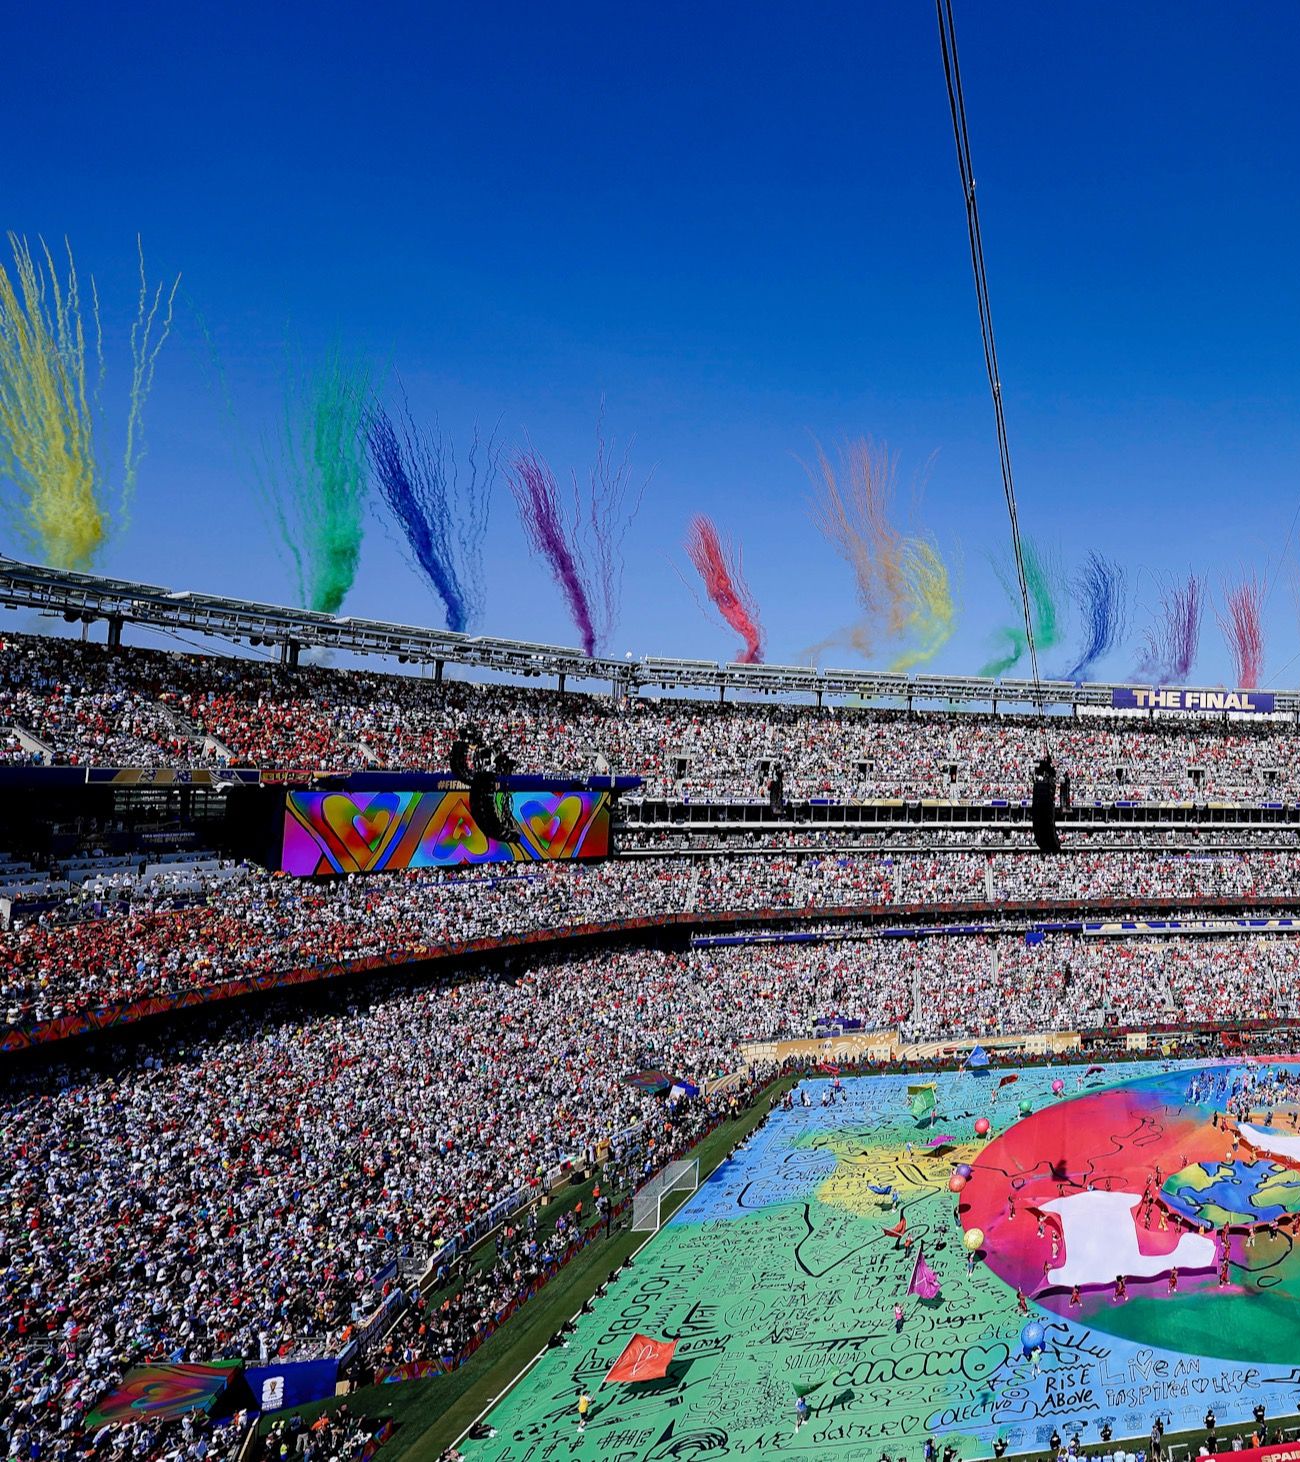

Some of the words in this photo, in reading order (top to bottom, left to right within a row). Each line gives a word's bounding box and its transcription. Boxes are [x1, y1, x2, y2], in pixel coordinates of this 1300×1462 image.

[1132, 689, 1181, 708] THE
[1185, 690, 1256, 710] FINAL
[1202, 920, 1241, 928] FINAL
[930, 1310, 994, 1332] jugar
[784, 1350, 867, 1372] SOLIDARIDAD
[924, 1399, 1011, 1431] COLECTIVO
